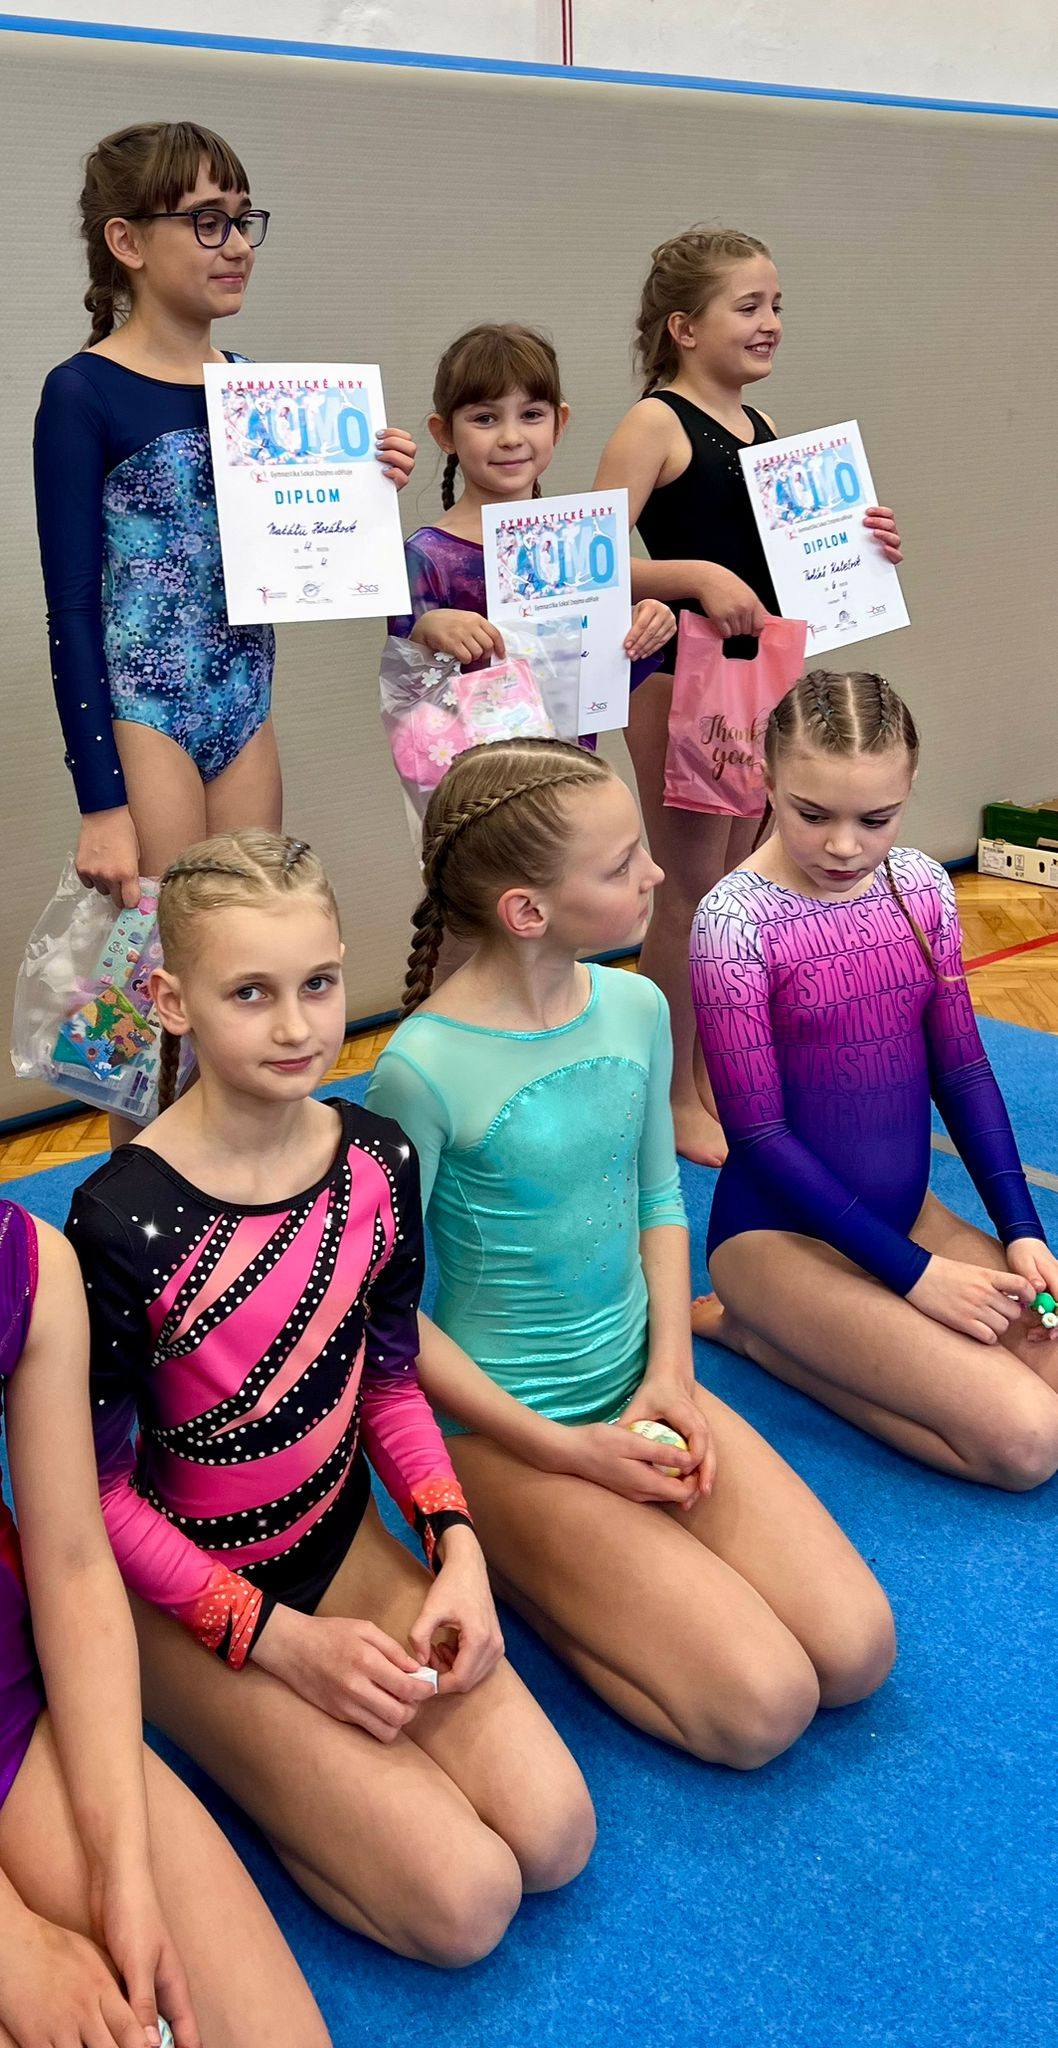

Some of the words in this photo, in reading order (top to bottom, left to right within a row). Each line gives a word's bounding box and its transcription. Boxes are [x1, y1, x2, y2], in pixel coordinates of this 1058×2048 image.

[227, 379, 329, 390] GYMNASTICKÉ
[338, 380, 364, 390] HRY
[274, 488, 340, 505] DIPLOM
[500, 508, 584, 530] GYMNASTICKÉ
[591, 506, 613, 518] HRY
[803, 531, 849, 555] DIPLOM
[712, 747, 766, 781] you
